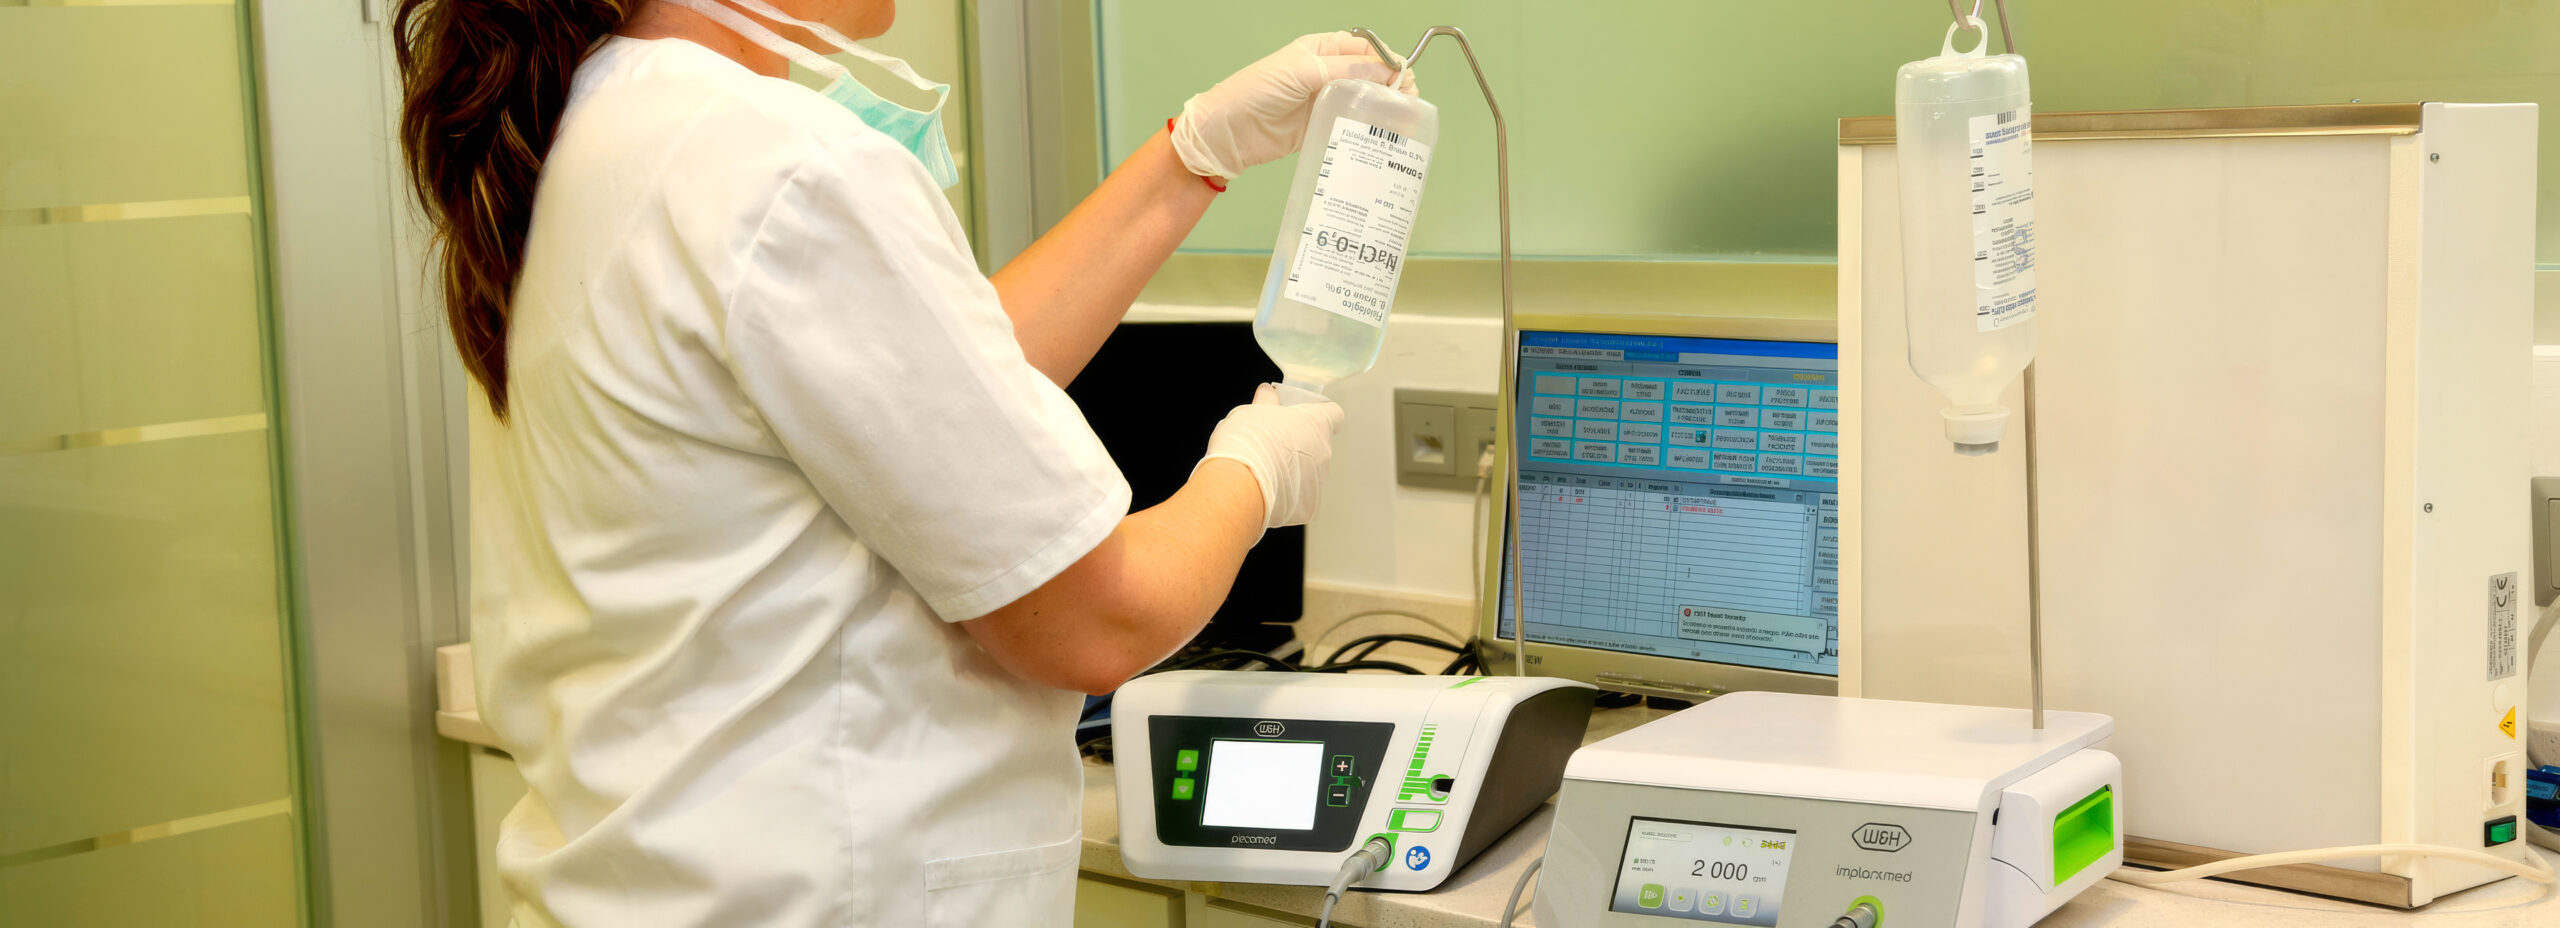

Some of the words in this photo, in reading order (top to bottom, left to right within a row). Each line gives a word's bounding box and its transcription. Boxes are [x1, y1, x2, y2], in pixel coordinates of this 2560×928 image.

[1862, 828, 1901, 847] W&H
[1691, 859, 1706, 877] 2
[1710, 861, 1749, 881] 000
